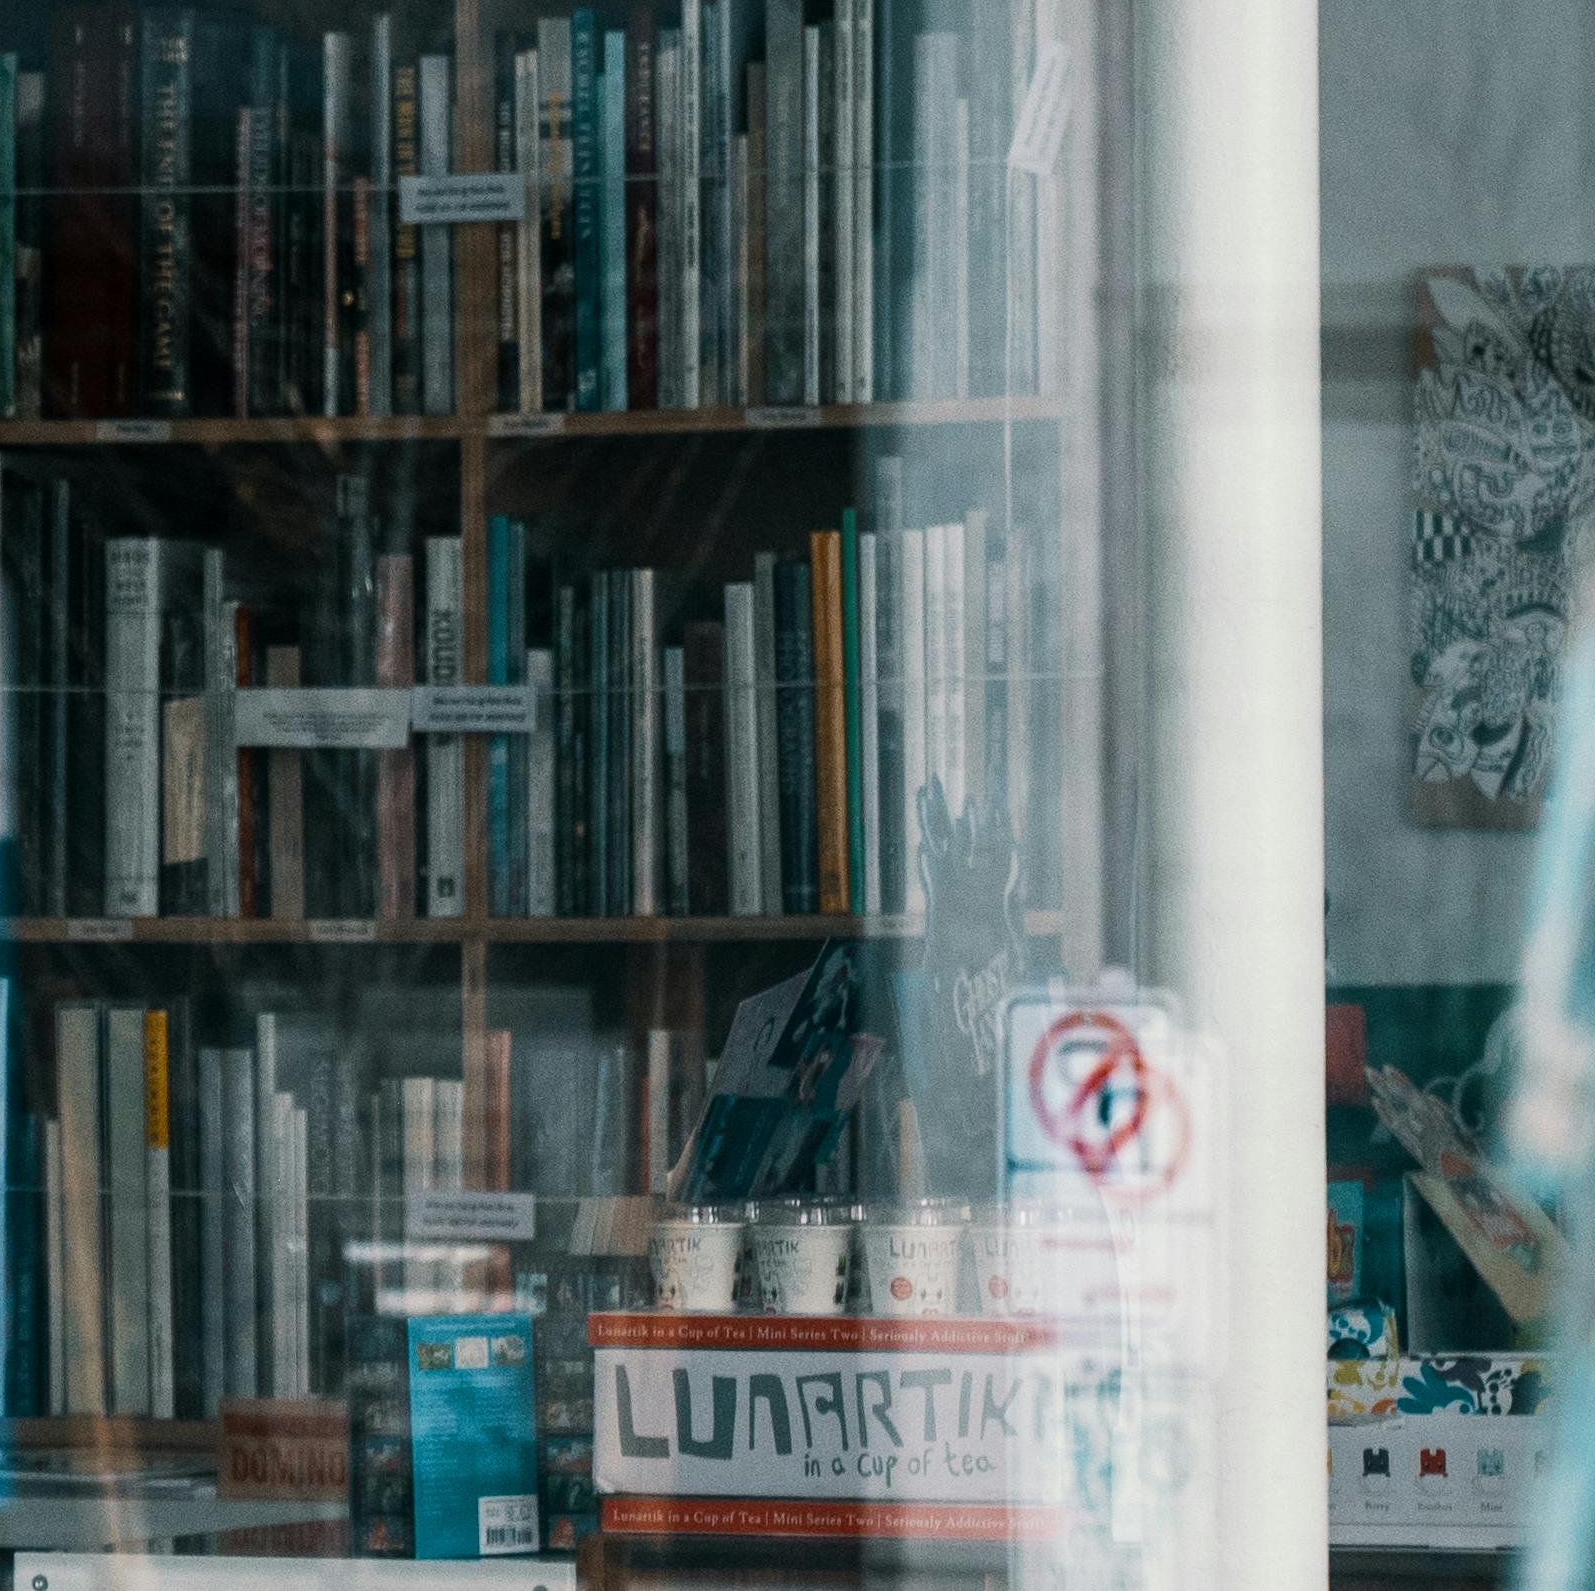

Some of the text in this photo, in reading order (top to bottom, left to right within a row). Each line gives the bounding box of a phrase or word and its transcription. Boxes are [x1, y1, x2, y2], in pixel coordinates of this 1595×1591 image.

[678, 1325, 703, 1340] Cup
[706, 1326, 720, 1338] of
[722, 1326, 746, 1338] Tea
[757, 1327, 786, 1339] Mini
[789, 1327, 827, 1340] Series
[830, 1329, 859, 1341] Two
[614, 1364, 1024, 1461] LUNARTIK
[804, 1453, 821, 1478] in
[831, 1459, 848, 1477] a
[908, 1448, 932, 1476] of
[943, 1441, 997, 1477] tea
[613, 1509, 663, 1522] Lunartik
[693, 1511, 720, 1527] Cup
[722, 1512, 736, 1523] of
[738, 1512, 761, 1524] Tea
[773, 1512, 803, 1525] Mini
[806, 1513, 842, 1527] Series
[846, 1514, 874, 1526] Two
[884, 1514, 941, 1530] Seriously
